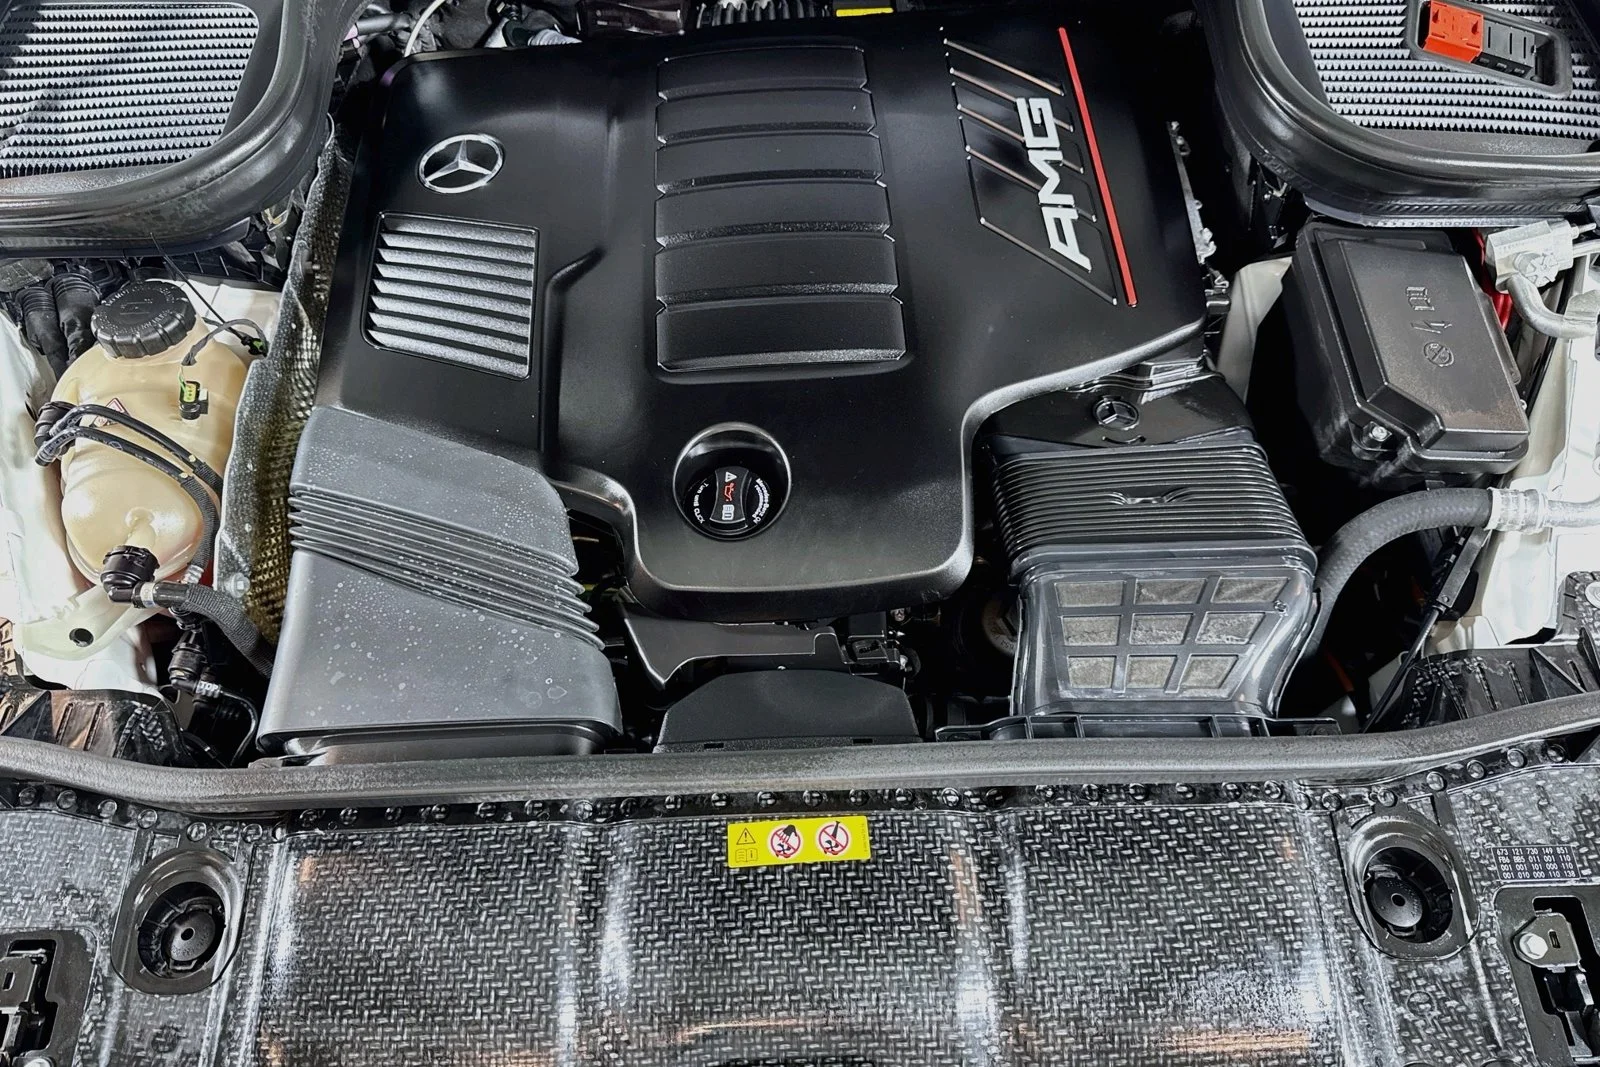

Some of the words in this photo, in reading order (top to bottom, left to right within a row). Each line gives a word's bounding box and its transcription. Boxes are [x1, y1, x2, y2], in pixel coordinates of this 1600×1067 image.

[1016, 98, 1092, 272] AMG
[696, 482, 709, 494] Turn
[693, 507, 705, 524] CLICK
